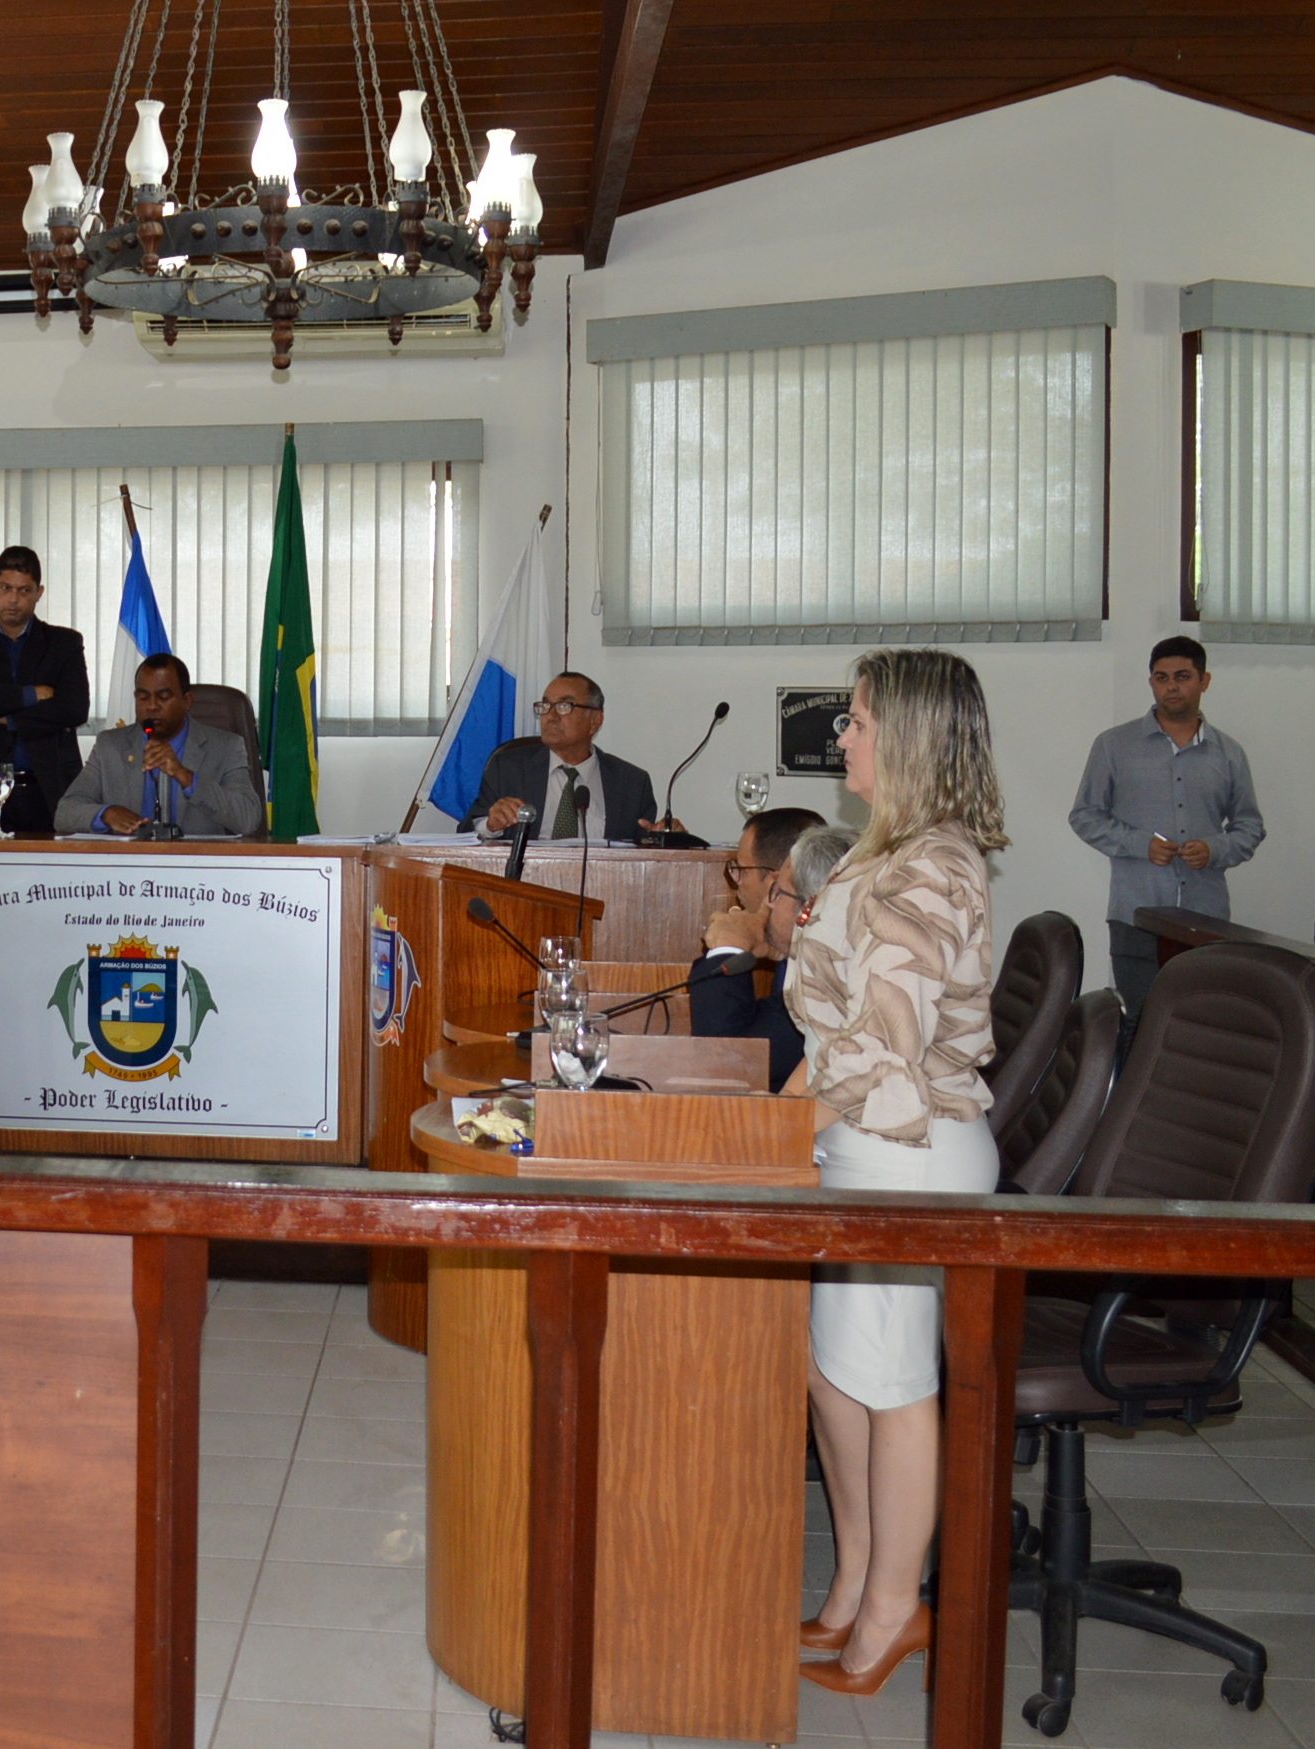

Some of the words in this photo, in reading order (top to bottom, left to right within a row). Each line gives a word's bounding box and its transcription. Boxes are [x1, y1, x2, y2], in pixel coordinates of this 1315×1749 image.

[25, 880, 112, 904] Municipal
[119, 881, 136, 897] de
[140, 880, 215, 906] Armação
[222, 888, 252, 907] dos
[257, 891, 321, 923] Búzios
[64, 913, 102, 926] Estado
[106, 914, 120, 926] do
[160, 915, 205, 928] Janeiro
[99, 961, 130, 969] ARMAÇÃO
[144, 962, 167, 970] BÚZIOS
[39, 1087, 97, 1111] Poder
[104, 1089, 213, 1113] Legislativo
